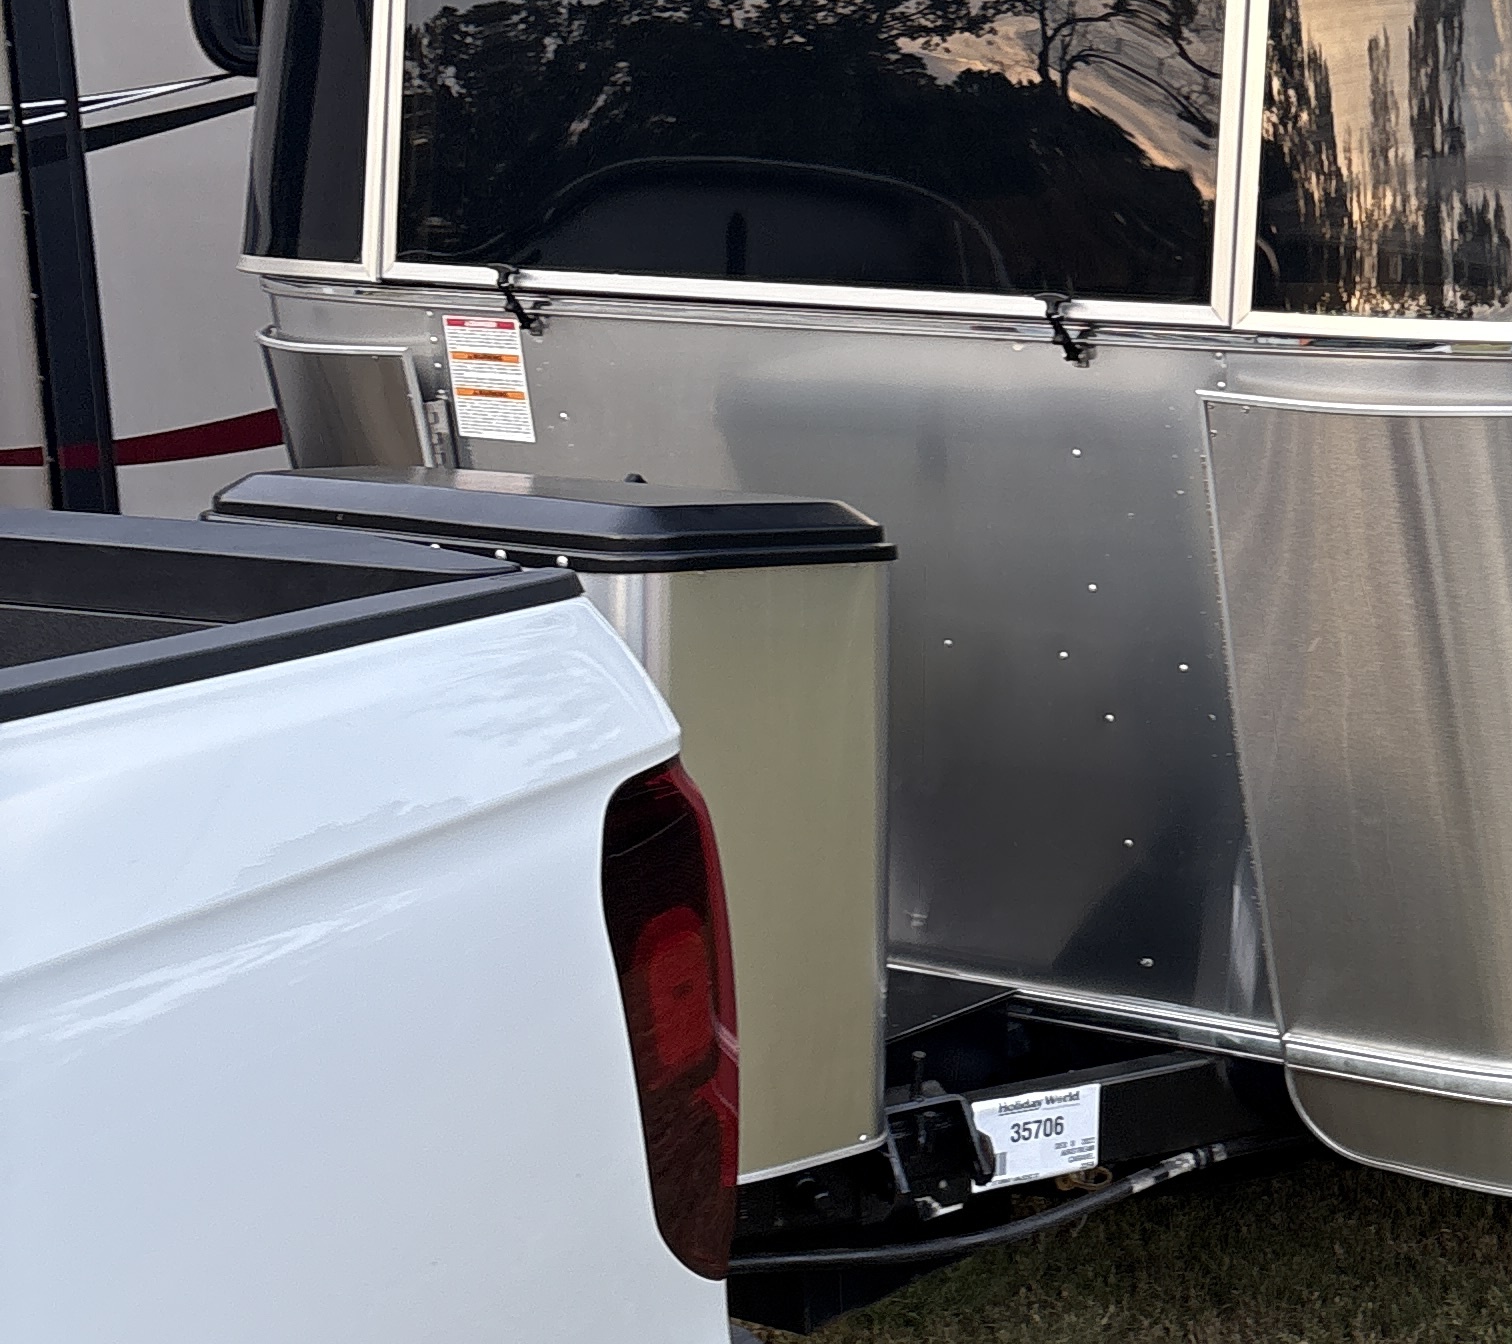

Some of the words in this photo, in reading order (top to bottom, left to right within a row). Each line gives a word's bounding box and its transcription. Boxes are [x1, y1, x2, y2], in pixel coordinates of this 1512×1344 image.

[997, 1099, 1043, 1113] Holiday
[1044, 1090, 1080, 1105] World
[1010, 1115, 1064, 1143] 35706
